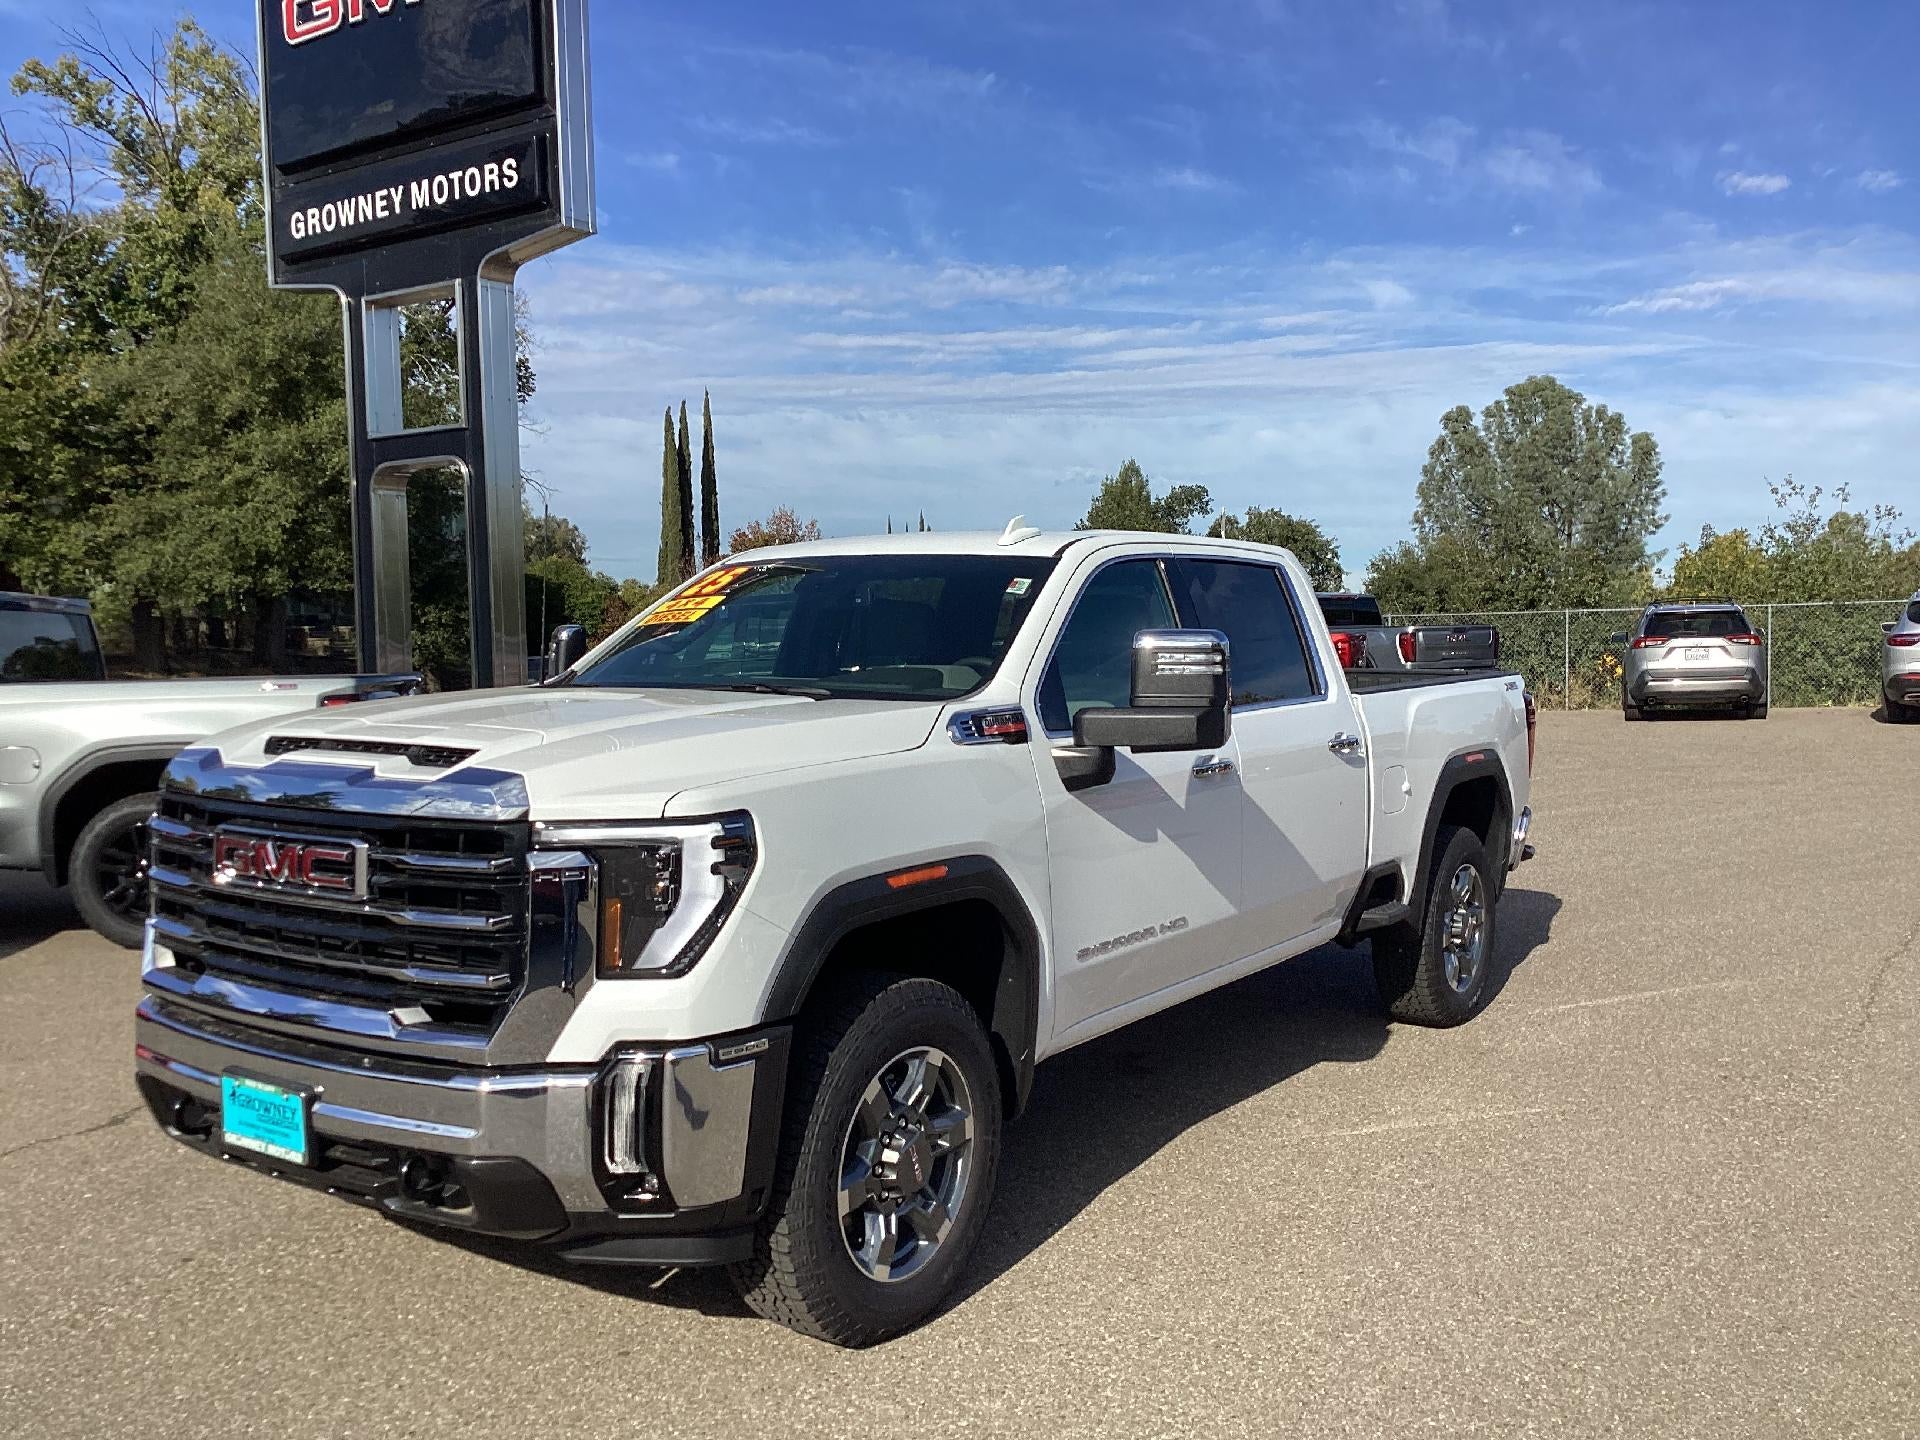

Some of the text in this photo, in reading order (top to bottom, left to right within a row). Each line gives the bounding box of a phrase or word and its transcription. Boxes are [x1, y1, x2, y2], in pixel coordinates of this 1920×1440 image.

[290, 157, 519, 239] GROWNEY MOTORS
[215, 836, 353, 890] GMC
